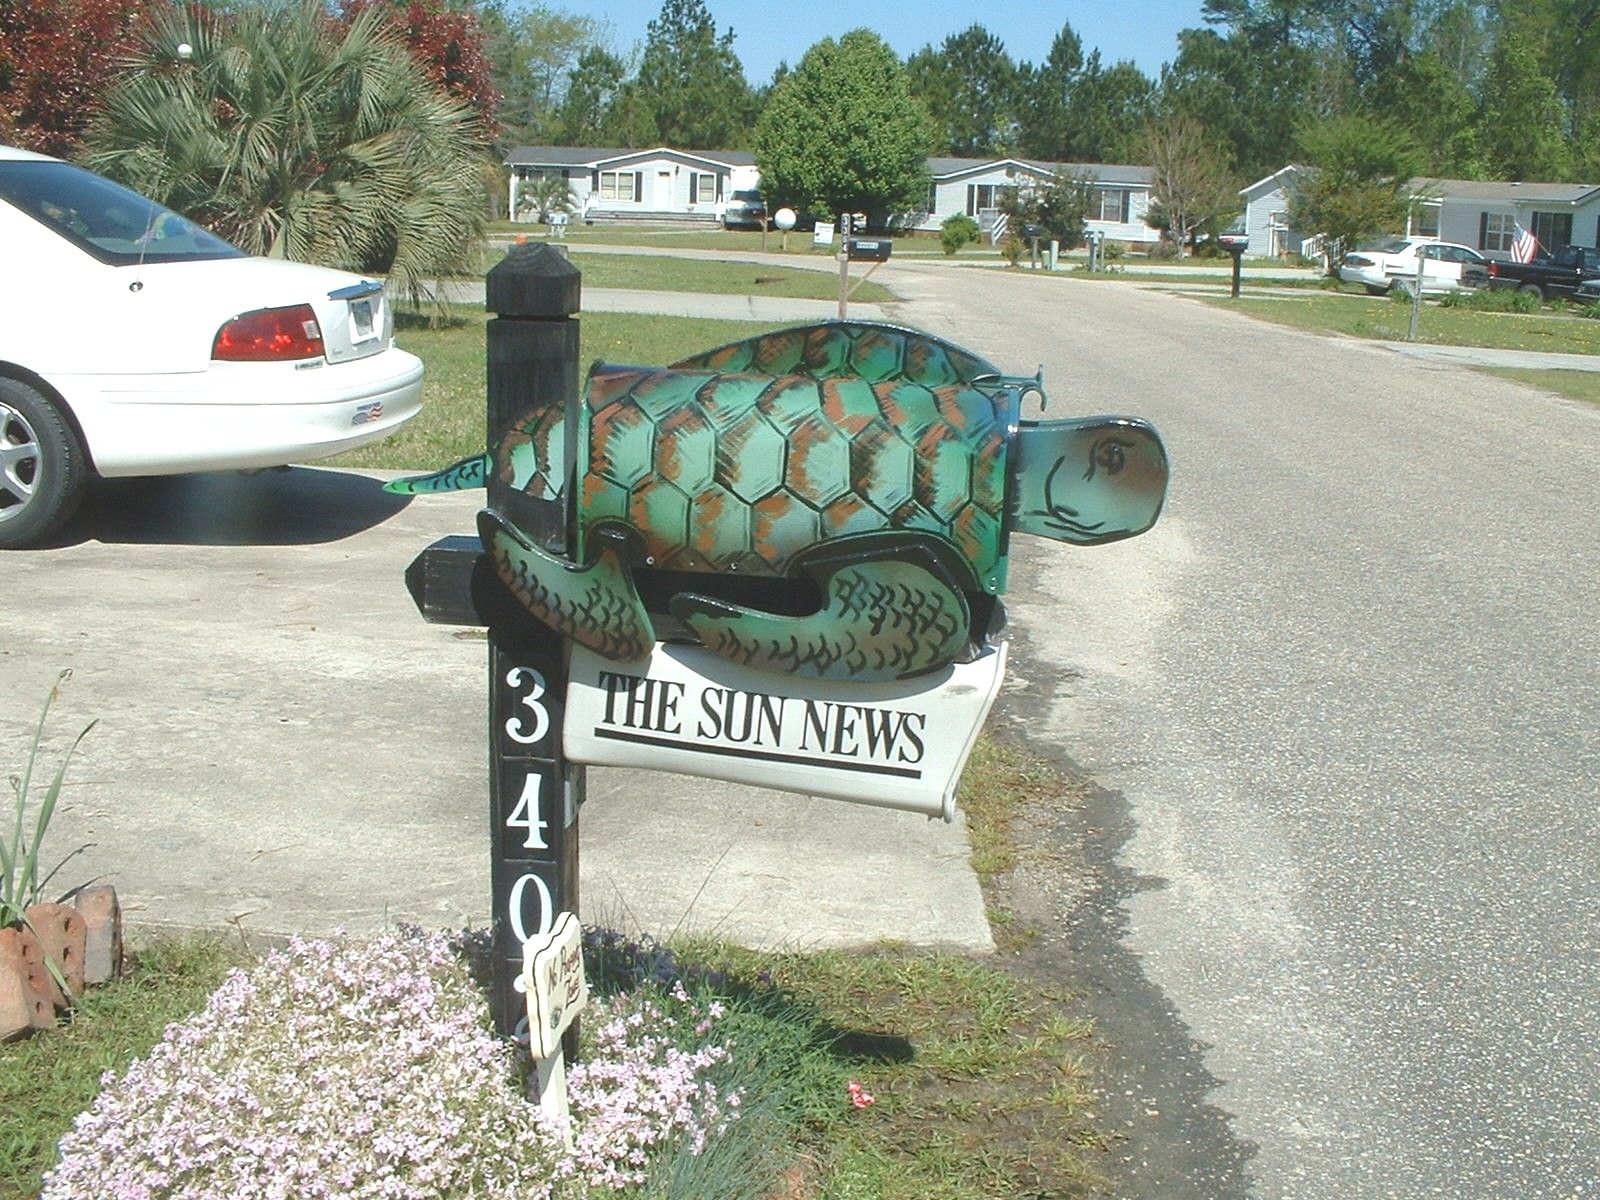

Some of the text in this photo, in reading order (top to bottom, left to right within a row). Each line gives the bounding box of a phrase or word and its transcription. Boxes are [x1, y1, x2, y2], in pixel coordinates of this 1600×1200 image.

[598, 671, 927, 764] THE SUN NEWS
